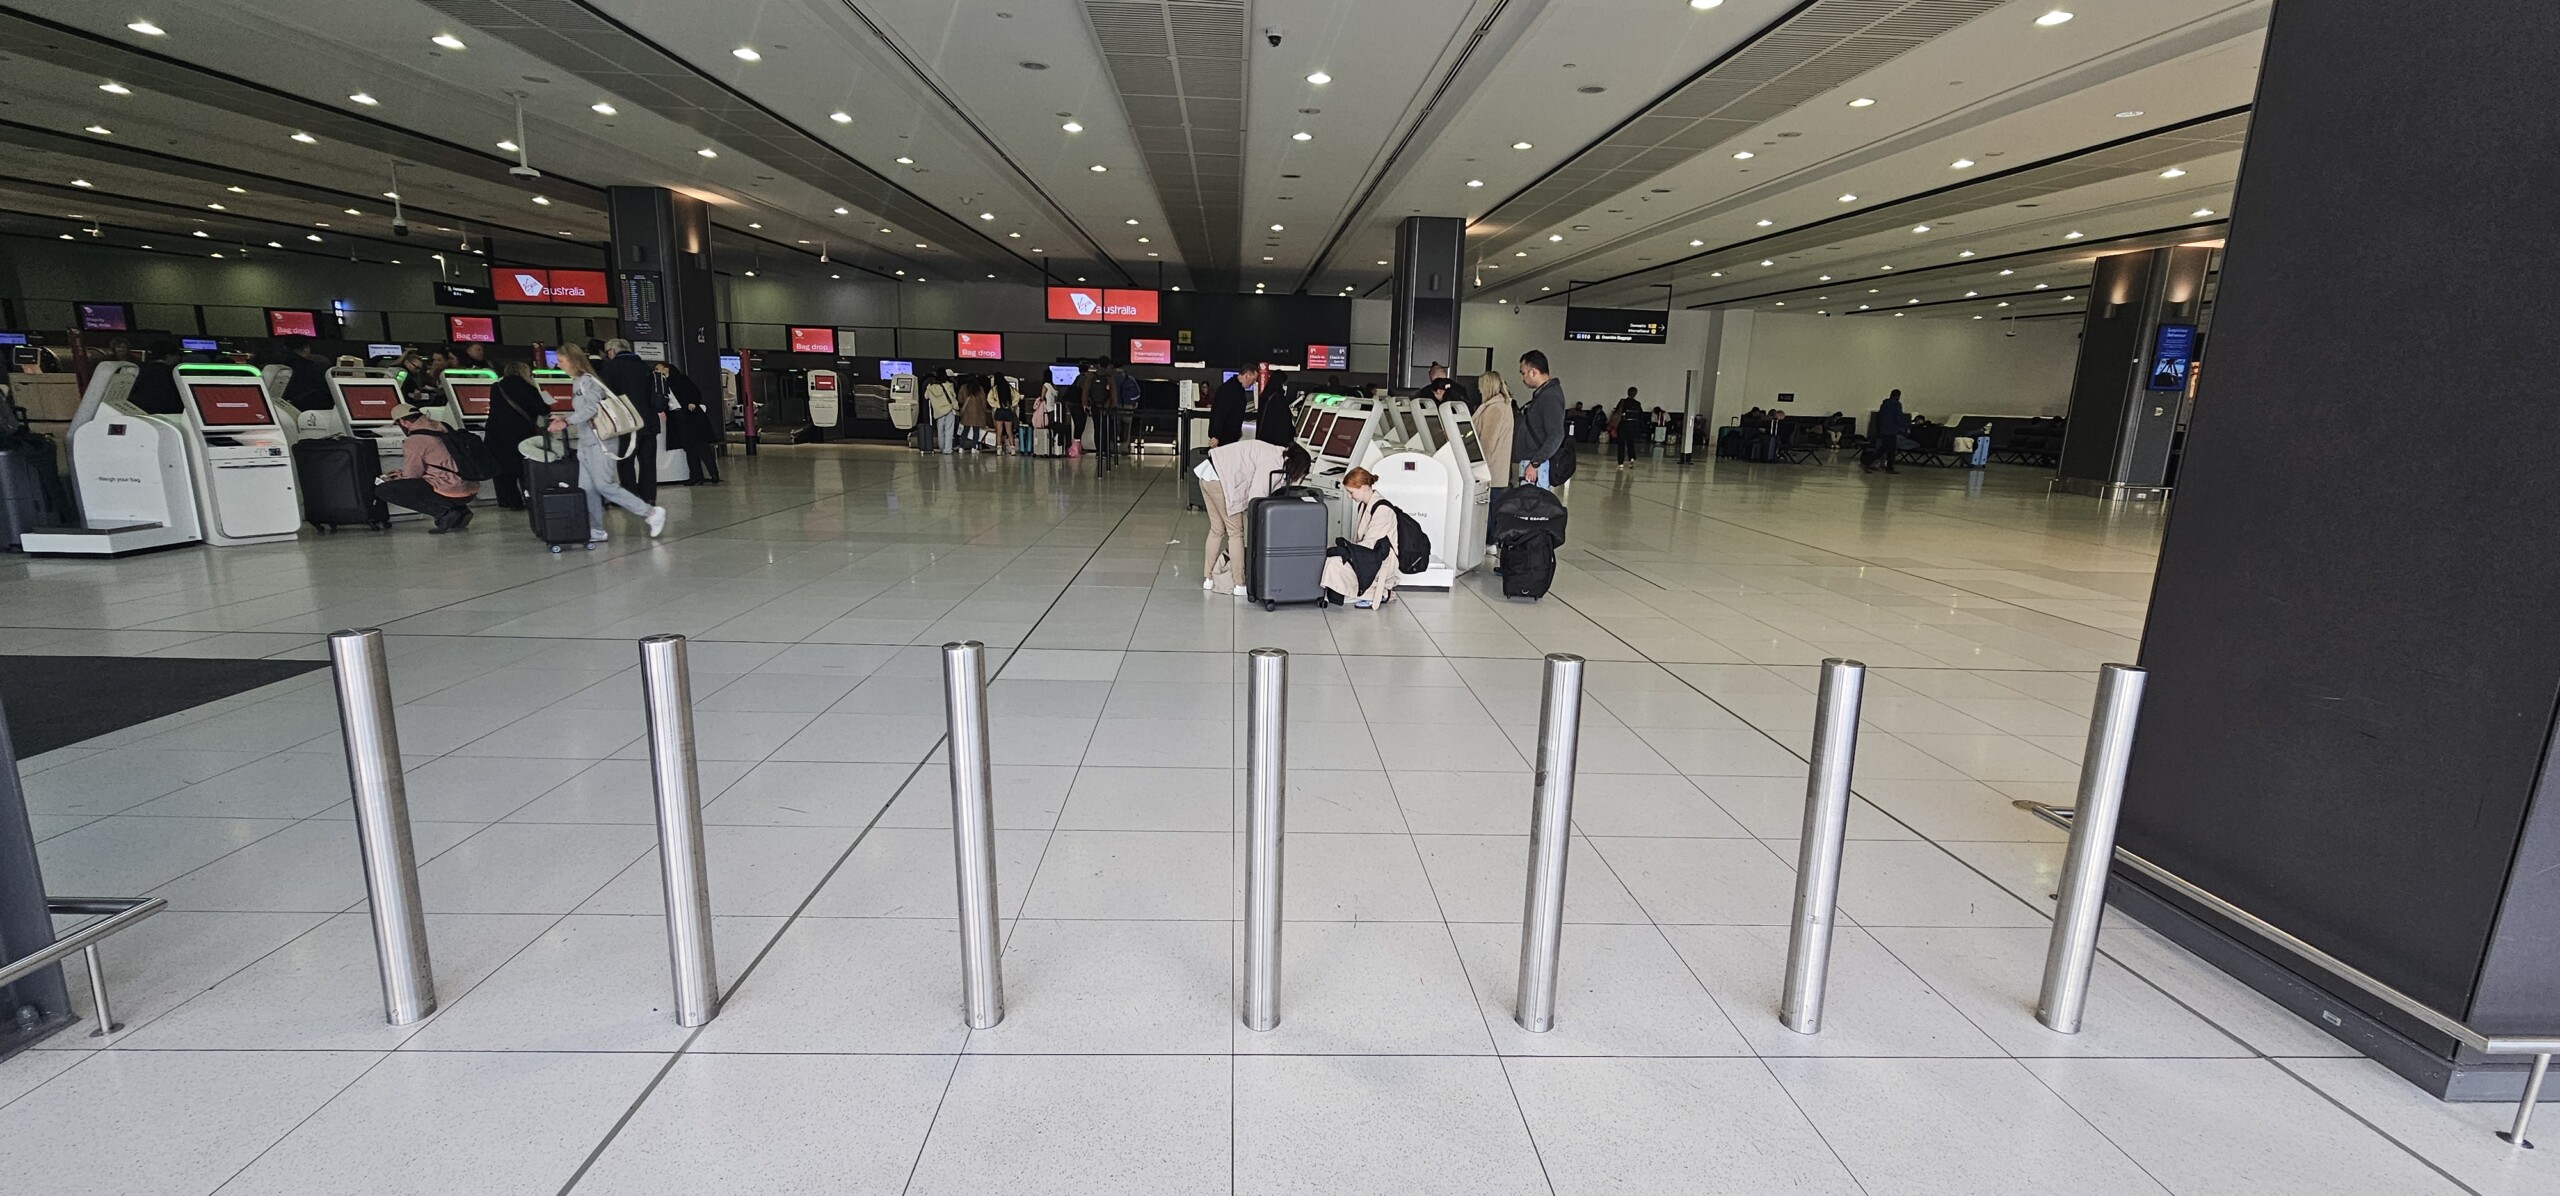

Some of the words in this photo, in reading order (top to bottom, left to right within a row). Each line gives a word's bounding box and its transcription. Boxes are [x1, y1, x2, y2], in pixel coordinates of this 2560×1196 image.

[543, 286, 586, 297] australia
[1095, 305, 1137, 316] australia
[277, 326, 293, 335] Bag
[293, 327, 310, 335] drop
[456, 332, 471, 340] Bag
[472, 332, 489, 340] drop
[796, 343, 811, 351] Bag
[811, 343, 829, 351] drop
[962, 349, 977, 357] Bag
[978, 349, 996, 357] drop
